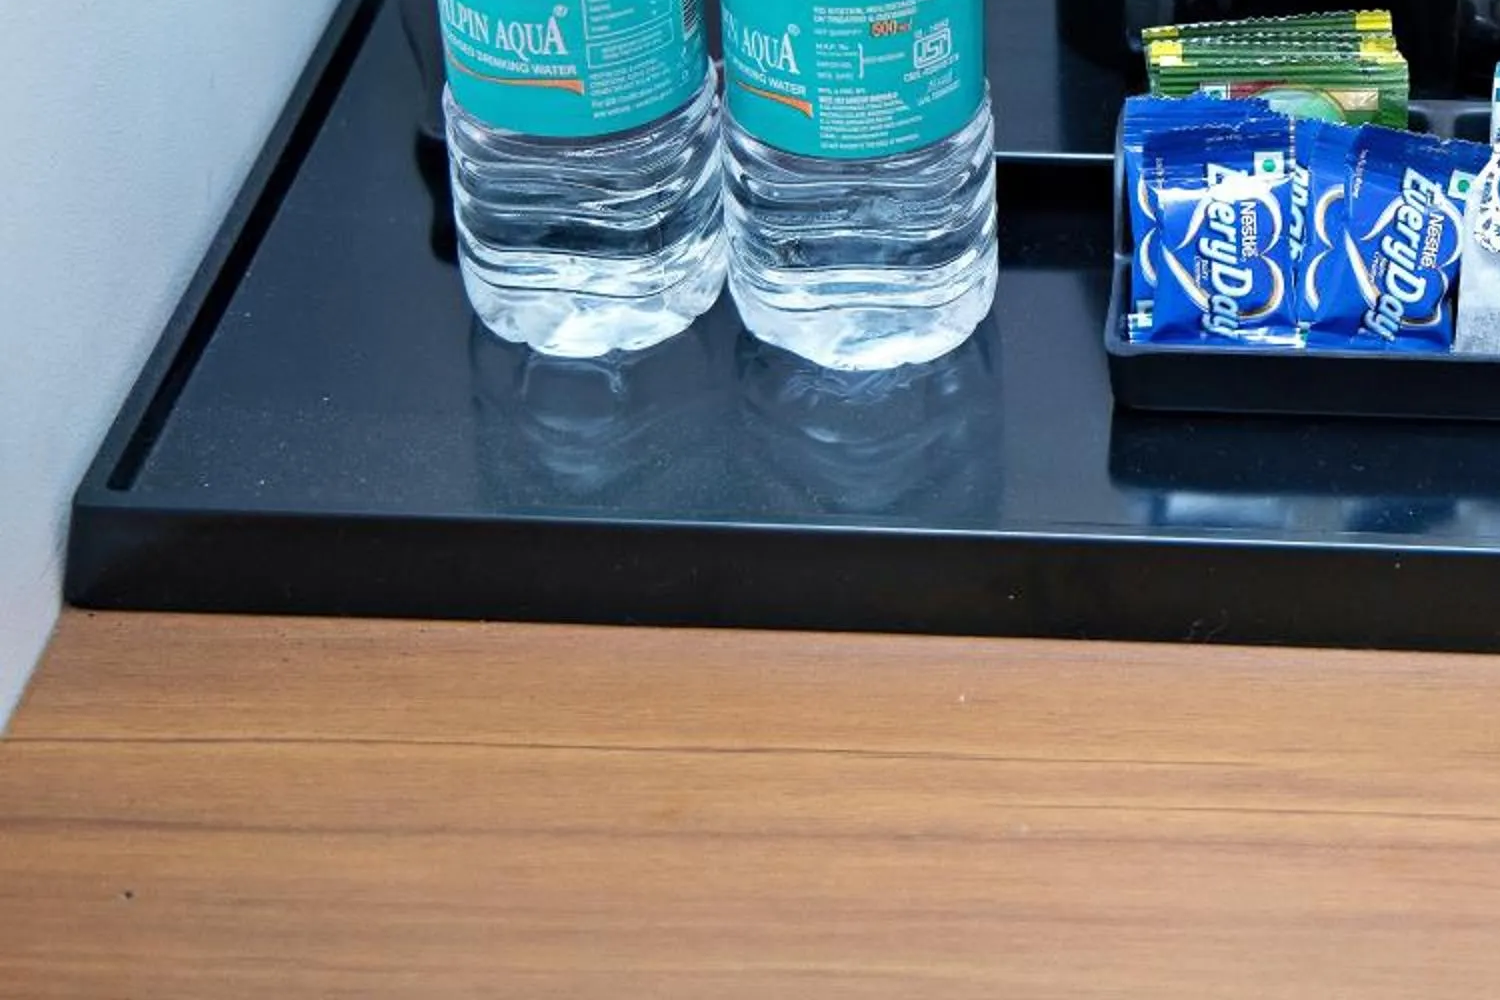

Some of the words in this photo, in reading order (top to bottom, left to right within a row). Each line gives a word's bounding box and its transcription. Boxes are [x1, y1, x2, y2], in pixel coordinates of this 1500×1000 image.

[495, 15, 569, 63] AQUA
[741, 25, 801, 75] AQUA
[531, 63, 577, 77] WATER
[767, 76, 807, 96] WATER
[1199, 162, 1253, 338] EeryDay
